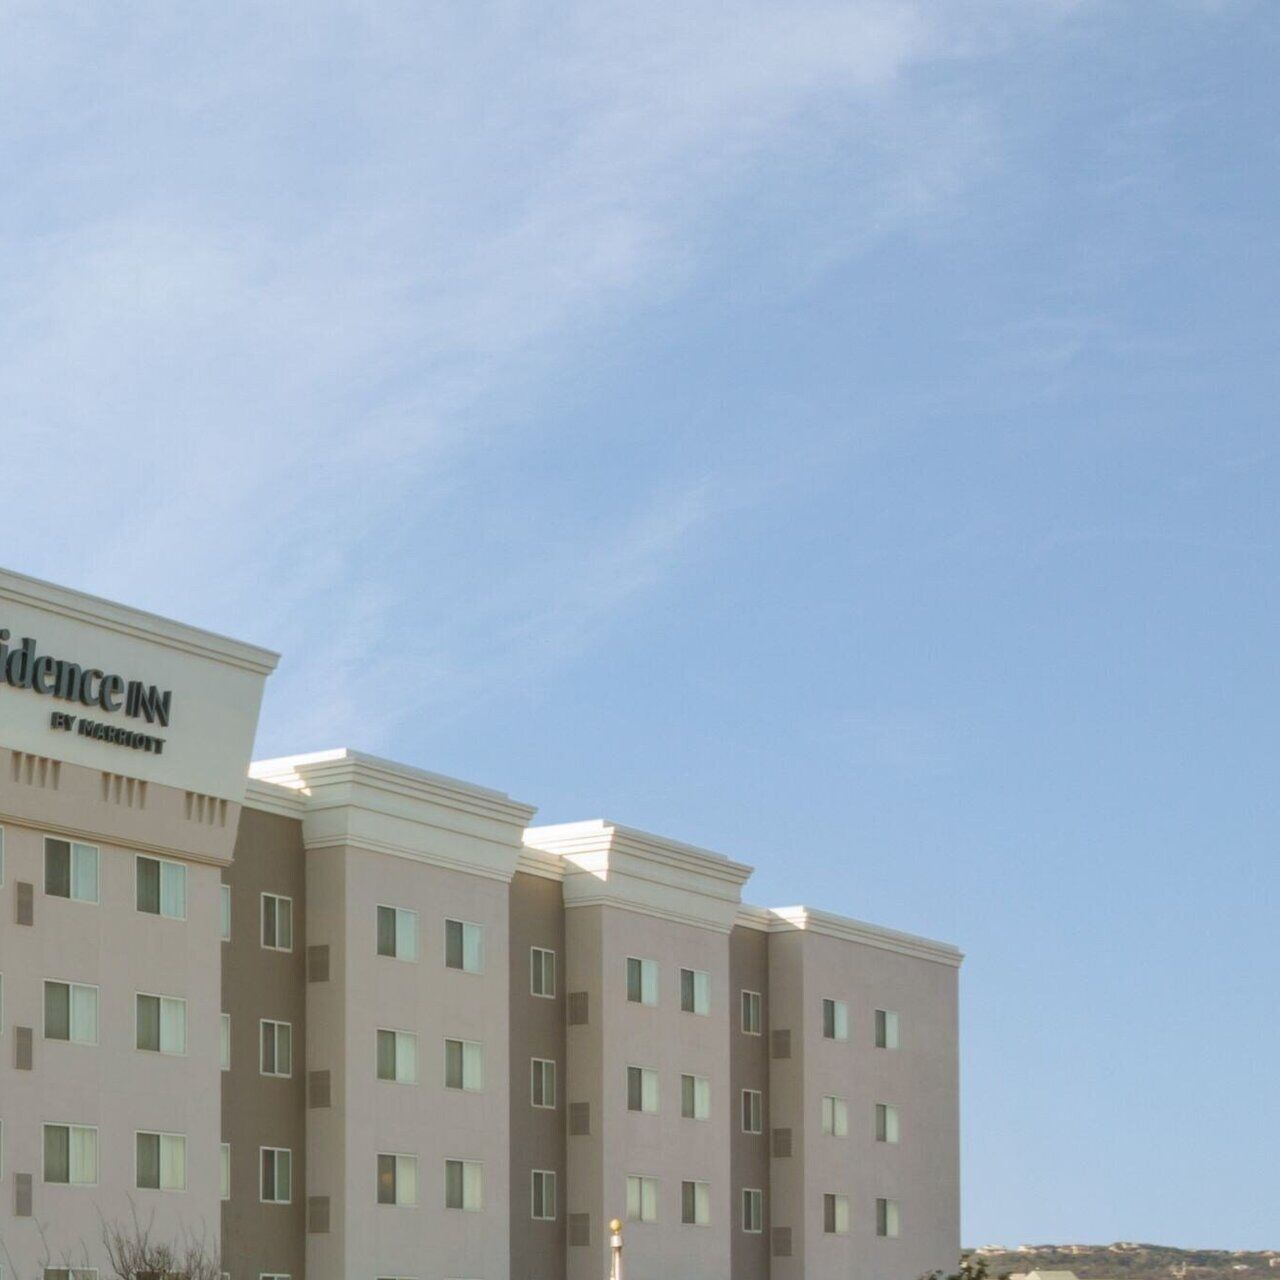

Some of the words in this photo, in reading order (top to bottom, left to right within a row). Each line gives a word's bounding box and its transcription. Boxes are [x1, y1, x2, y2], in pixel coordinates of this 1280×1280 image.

[125, 680, 172, 727] INN
[50, 711, 77, 731] BY
[78, 718, 167, 755] MARRIOTT
